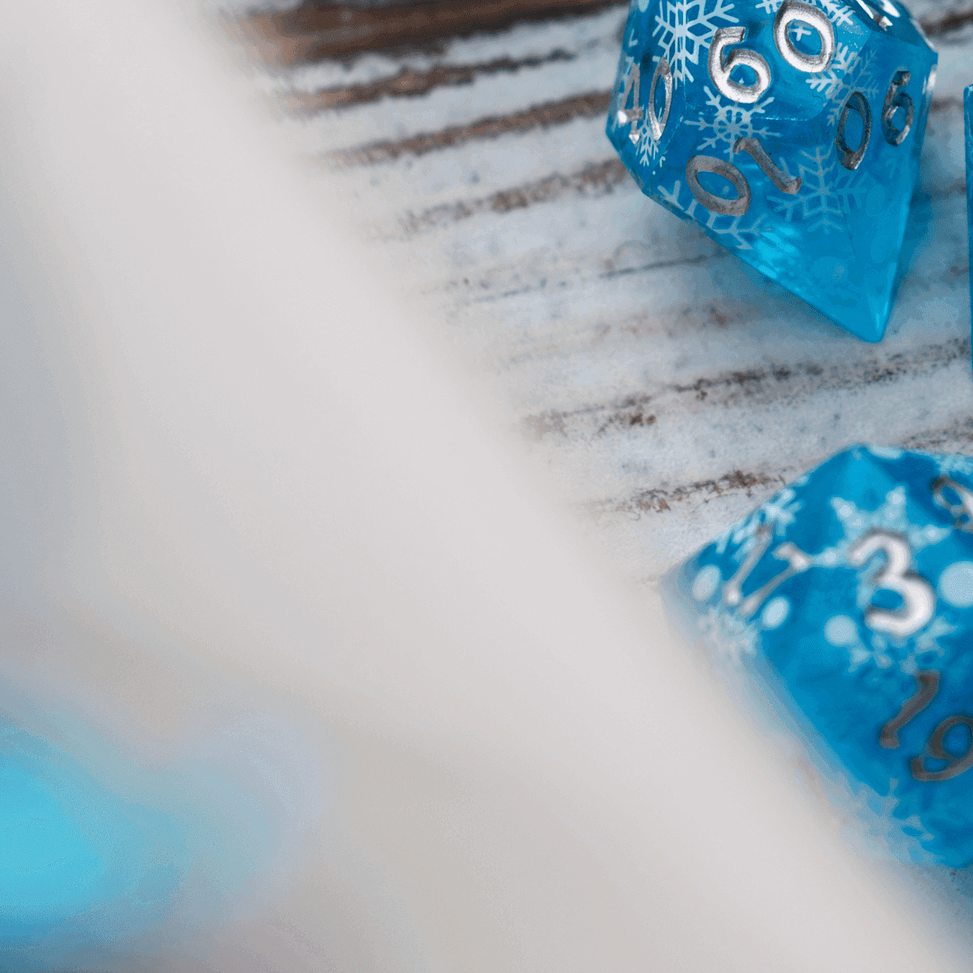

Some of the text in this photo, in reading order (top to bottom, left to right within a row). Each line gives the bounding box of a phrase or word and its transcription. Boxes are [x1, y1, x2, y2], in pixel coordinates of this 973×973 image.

[616, 56, 672, 144] 40
[708, 0, 835, 103] 60
[846, 529, 936, 635] 3
